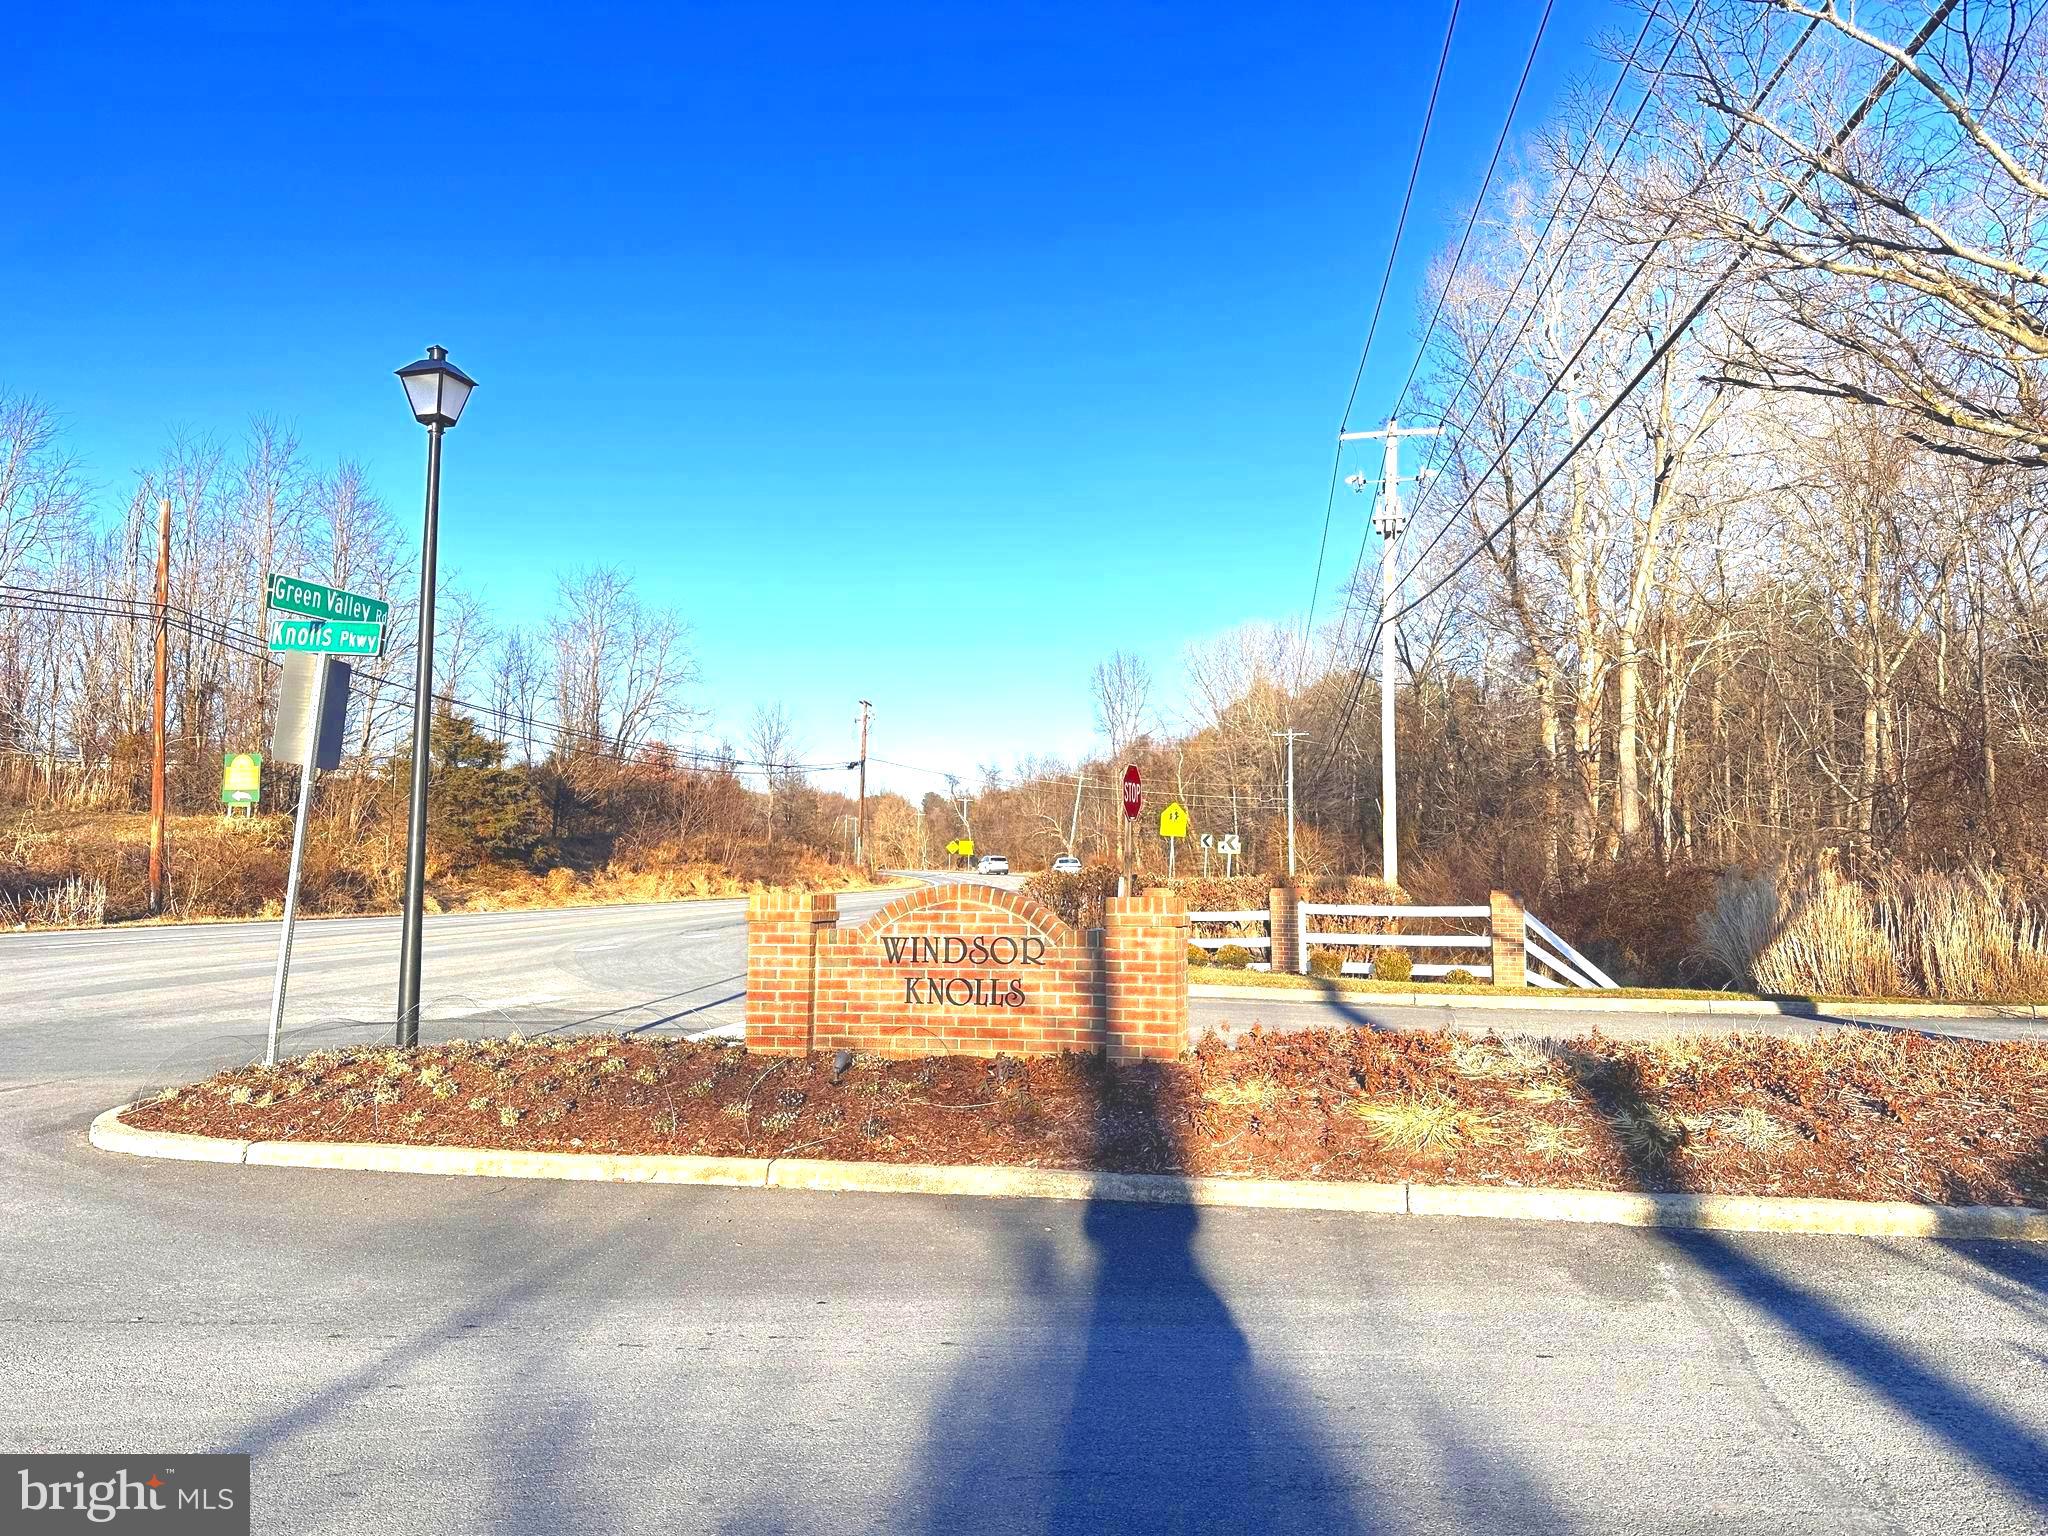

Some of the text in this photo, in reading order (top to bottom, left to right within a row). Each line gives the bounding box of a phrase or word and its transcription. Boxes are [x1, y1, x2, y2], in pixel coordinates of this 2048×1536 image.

[275, 578, 387, 624] Green Valley Rd
[271, 622, 377, 652] Knolls Pkwy
[1124, 781, 1141, 803] STOP
[881, 936, 1046, 965] WINDSOR
[904, 977, 1026, 1007] KNOLLS
